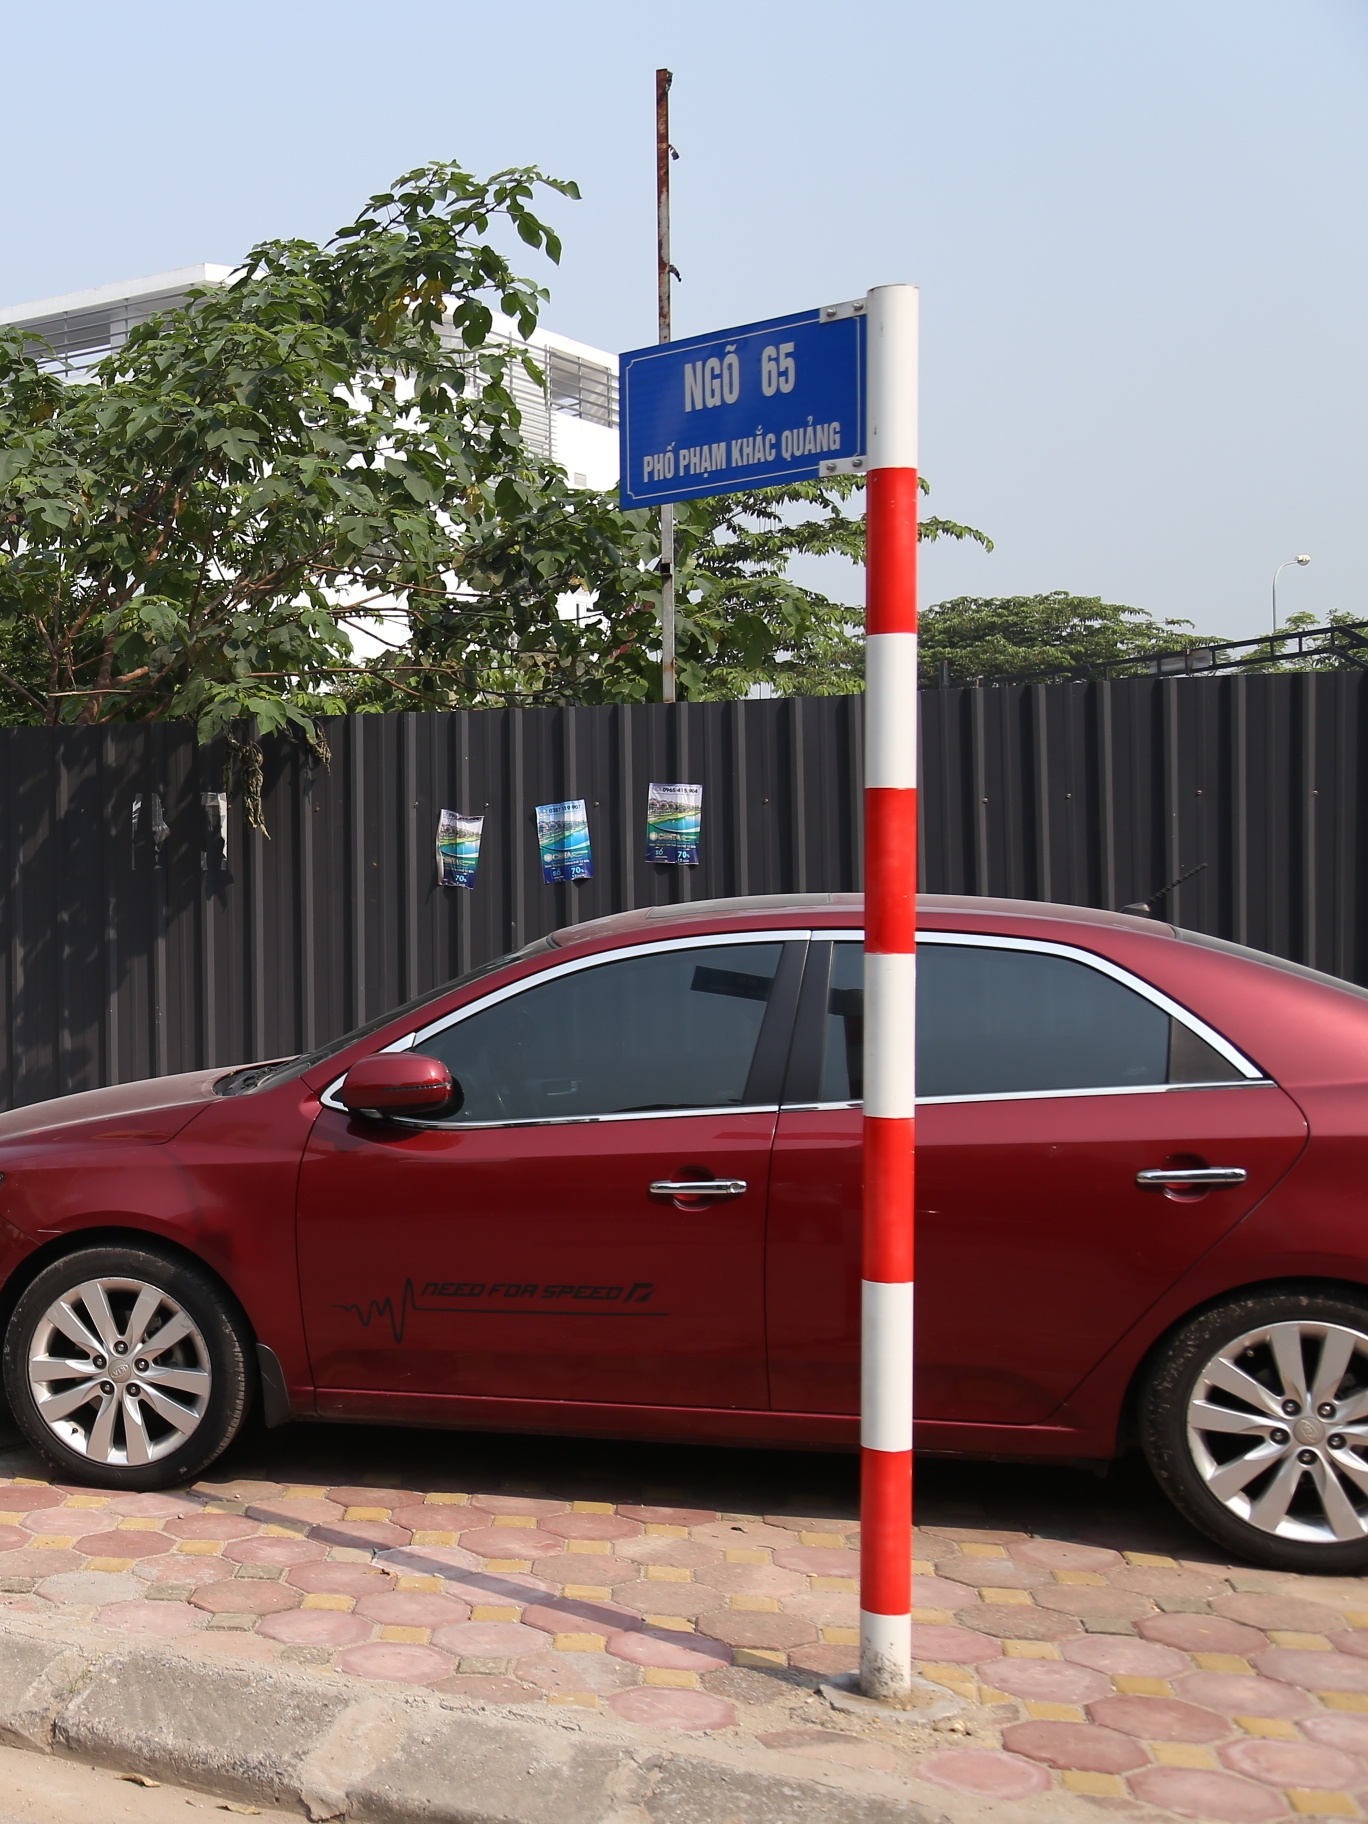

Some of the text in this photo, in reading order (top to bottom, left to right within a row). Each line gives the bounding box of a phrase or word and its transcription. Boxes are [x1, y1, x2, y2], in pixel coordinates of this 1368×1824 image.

[684, 341, 796, 412] NGÕ 65
[643, 416, 841, 483] PHỐ PHẠM KHẮC QUẢNG
[421, 1282, 624, 1300] NEED FOR SPEED
